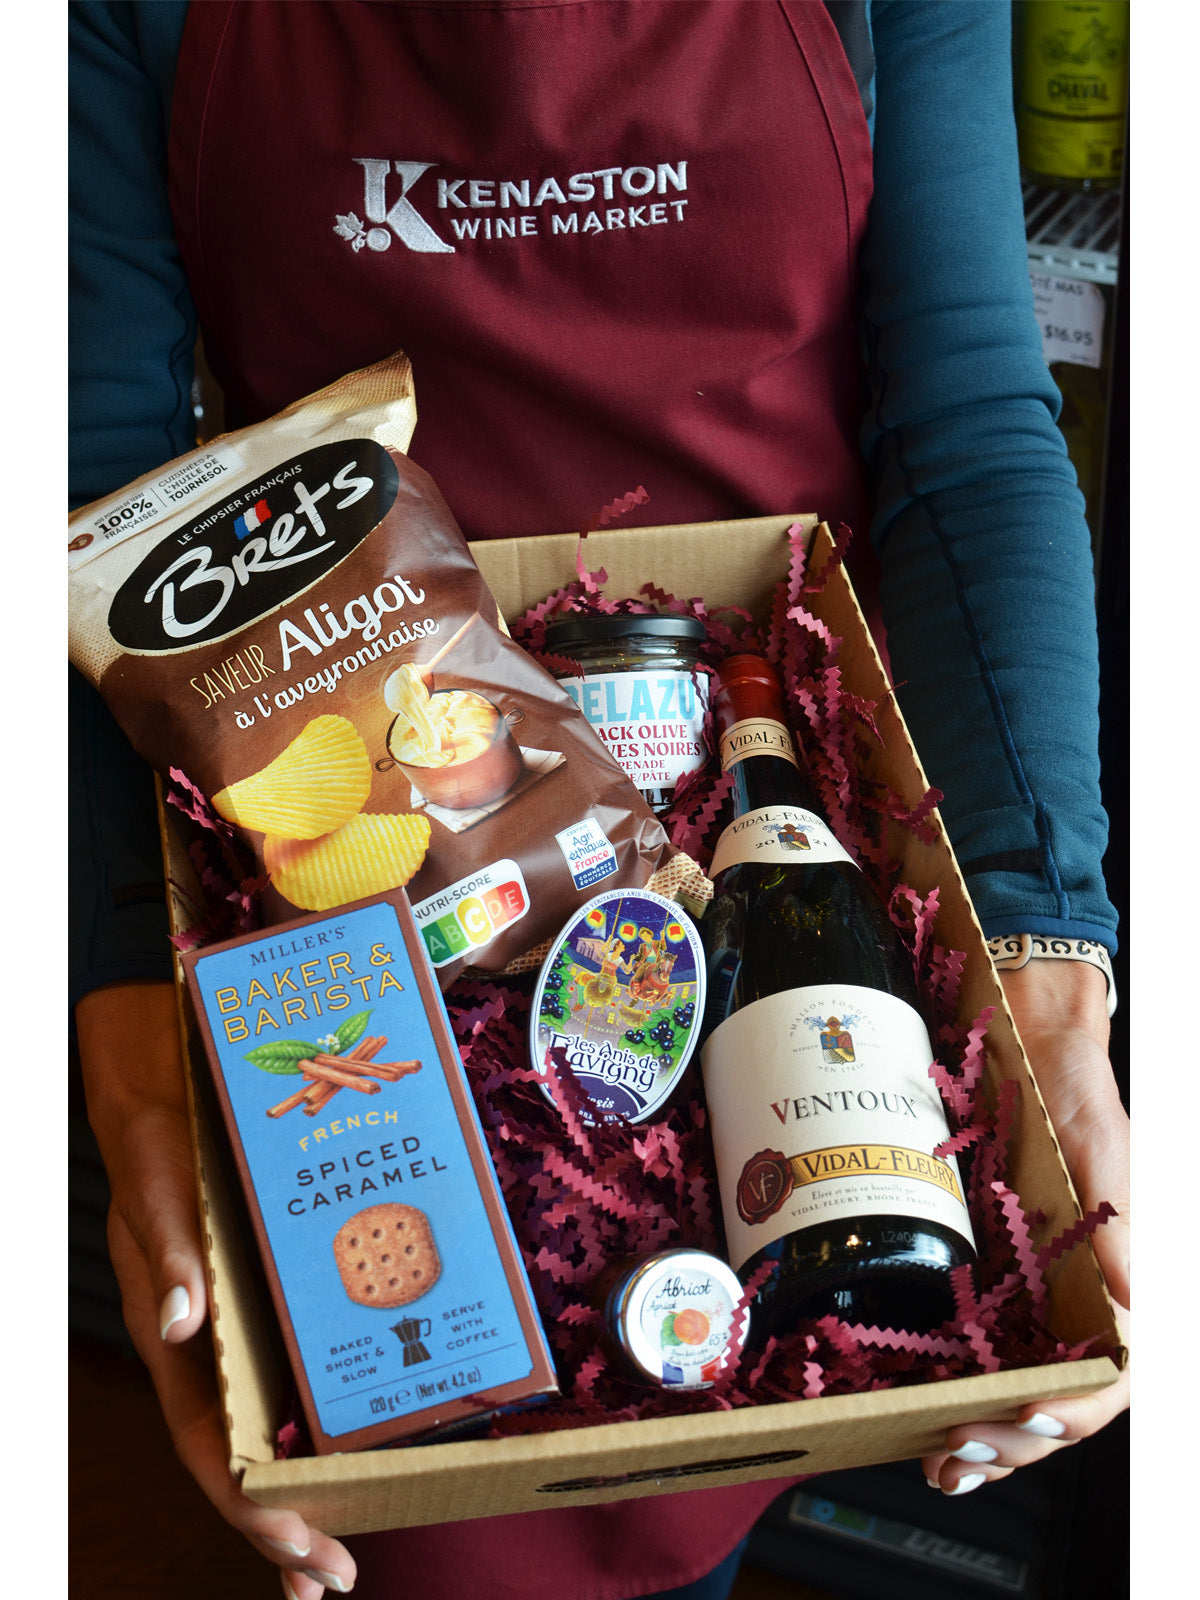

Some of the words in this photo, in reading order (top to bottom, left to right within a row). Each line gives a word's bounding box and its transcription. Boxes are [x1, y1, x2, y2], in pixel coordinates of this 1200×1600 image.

[437, 161, 688, 208] KENASTON
[451, 215, 538, 240] WINE
[552, 200, 688, 235] MARKET
[204, 458, 220, 470] DE
[168, 464, 228, 502] TOURNESOL
[98, 498, 153, 534] 100%
[177, 532, 193, 546] LE
[192, 499, 244, 535] CHIPSIER
[244, 464, 303, 501] FRANÇAIS
[105, 508, 158, 540] FRANÇAISES
[190, 645, 276, 709] SAVEUR
[278, 575, 425, 672] Aligot
[233, 708, 256, 729] à
[253, 618, 440, 718] l'aveyronnaise
[598, 726, 634, 741] ACK
[638, 725, 687, 739] OLIVE
[611, 743, 640, 758] VES
[643, 742, 700, 757] NOIRES
[619, 760, 665, 770] PENADE
[573, 831, 594, 848] Agri
[755, 839, 775, 849] 20
[574, 850, 609, 871] france
[579, 862, 611, 880] COMMERCE
[415, 873, 493, 920] NUTRI-SCORE
[643, 892, 651, 900] DE
[429, 935, 446, 955] A
[444, 924, 461, 944] B
[464, 907, 487, 933] C
[488, 901, 501, 920] D
[504, 890, 520, 909] E
[250, 926, 346, 967] MILLER'S
[215, 952, 354, 1014] BAKER
[370, 943, 395, 967] &
[223, 970, 405, 1044] BARISTA
[552, 1034, 656, 1093] avigny
[574, 1036, 596, 1054] les
[599, 1042, 636, 1065] Anis
[639, 1056, 658, 1071] de
[770, 1090, 918, 1126] VENTOUX
[298, 1110, 399, 1152] FRENCH
[297, 1136, 420, 1187] SPICED
[802, 1148, 955, 1192] VIDAL-FLEURY
[287, 1155, 447, 1216] CARAMEL
[791, 1204, 820, 1217] VIDAL
[656, 1276, 712, 1299] Abricot
[442, 1301, 485, 1320] SERVE
[451, 1317, 484, 1333] WITH
[330, 1336, 373, 1355] BAKED
[446, 1327, 499, 1350] COFFEE
[326, 1353, 369, 1373] SHORT
[375, 1346, 385, 1357] &
[341, 1365, 378, 1383] SLOW
[369, 1397, 387, 1414] 120
[416, 1383, 436, 1402] (Net
[436, 1380, 452, 1394] wt.
[452, 1371, 466, 1388] 4.2
[465, 1366, 482, 1385] oz)
